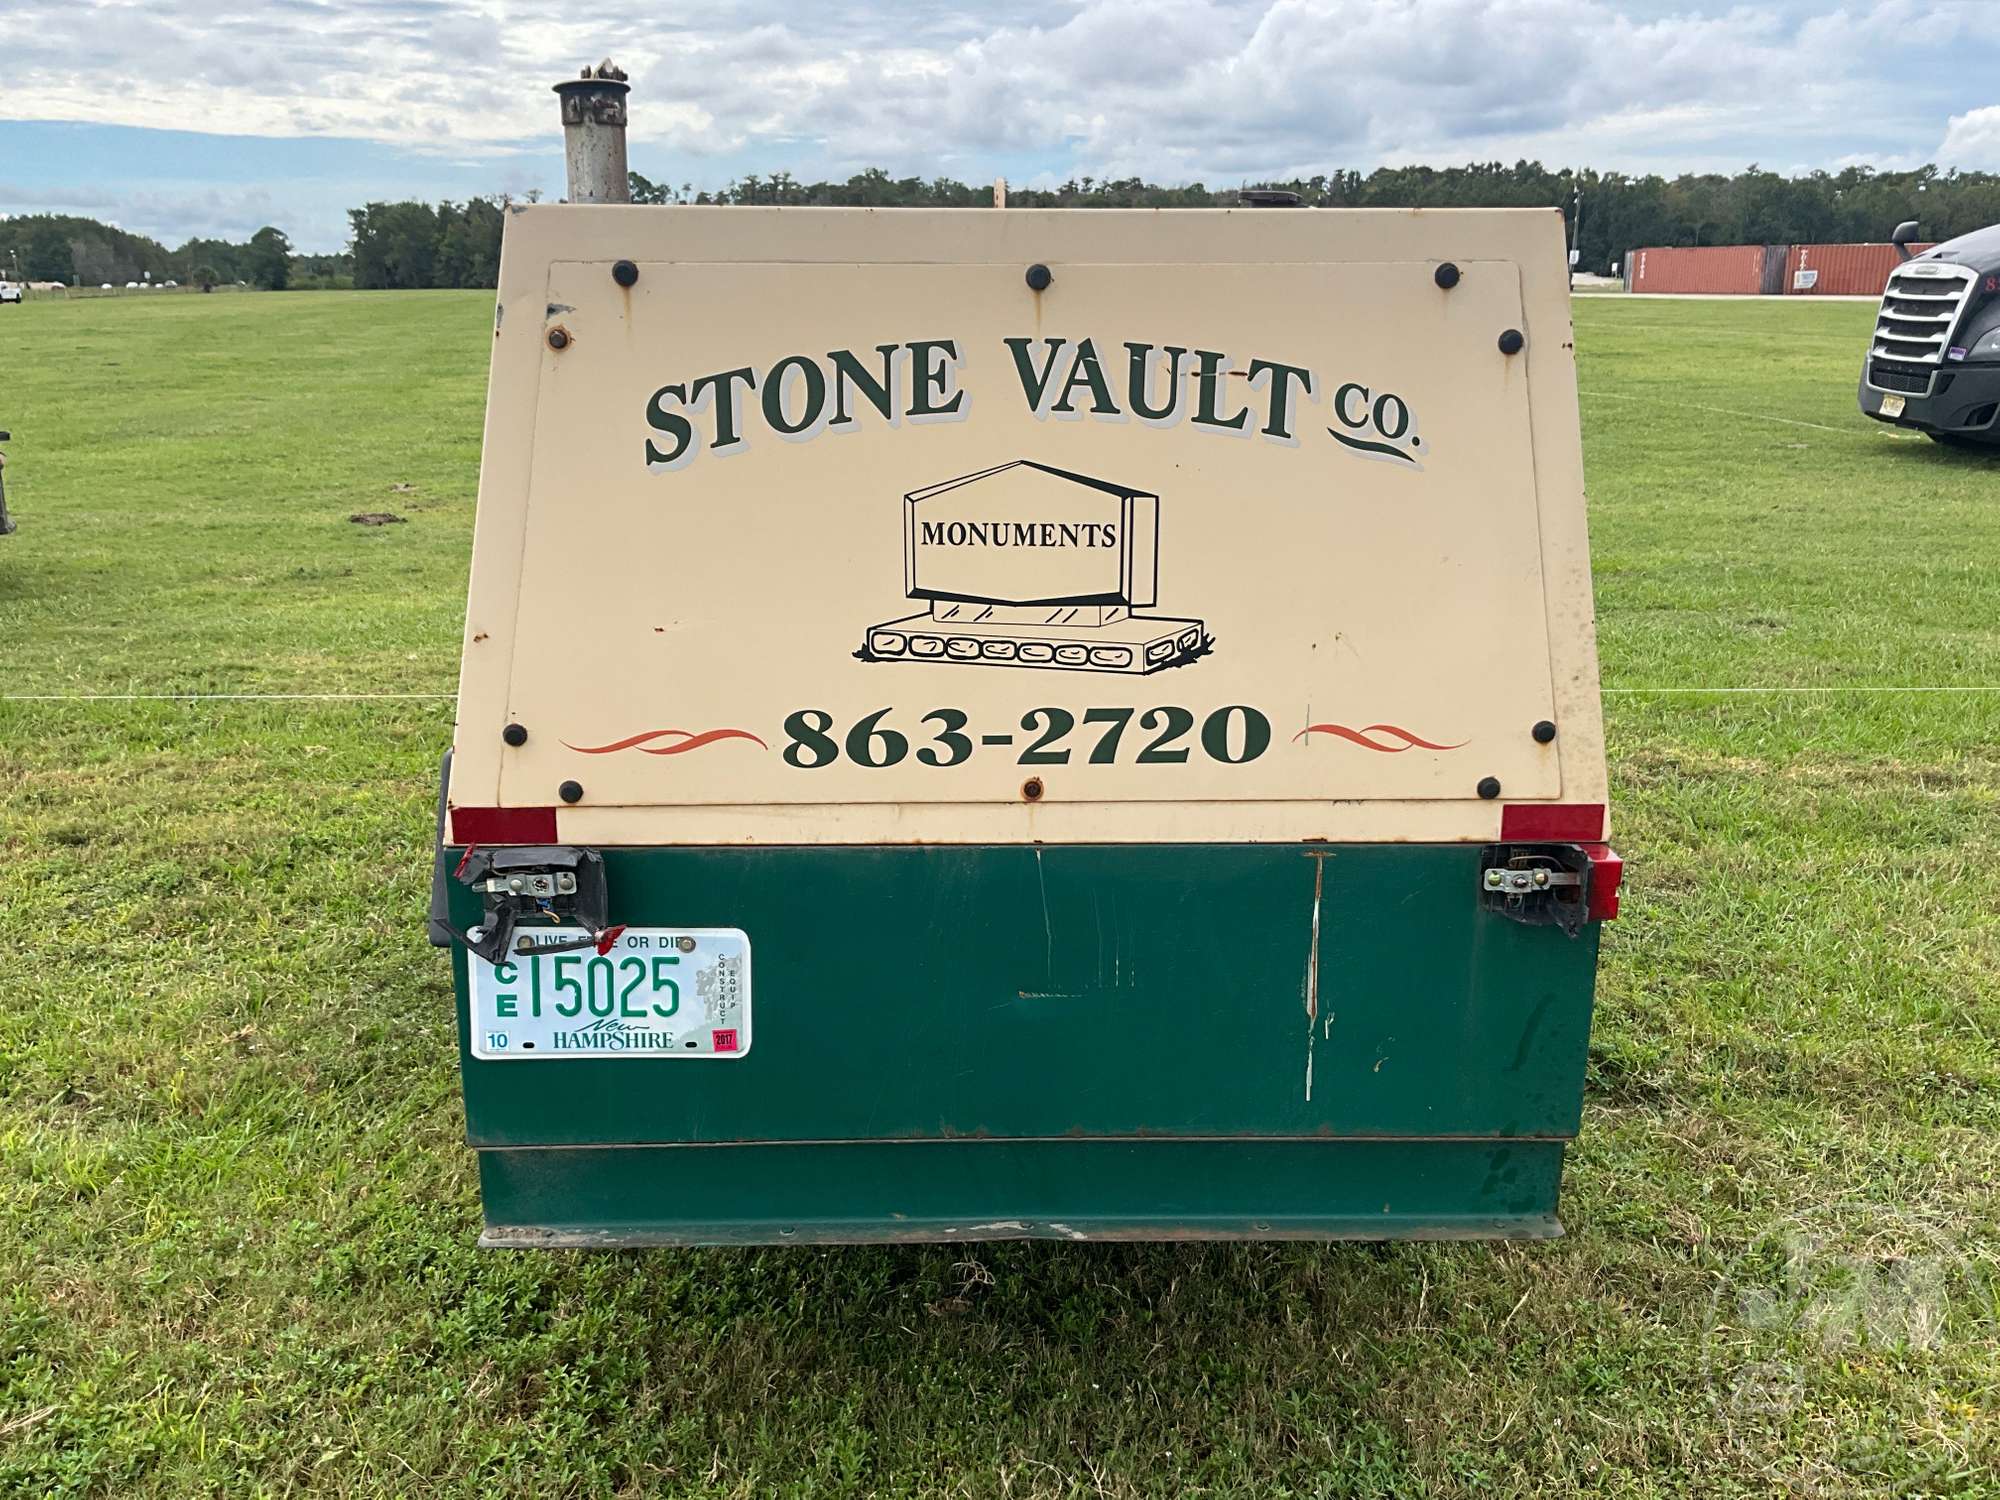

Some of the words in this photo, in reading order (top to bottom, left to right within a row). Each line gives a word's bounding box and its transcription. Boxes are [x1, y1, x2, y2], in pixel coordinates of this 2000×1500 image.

[645, 338, 965, 467] STONE
[1002, 336, 1313, 440] VAULT
[921, 520, 1117, 549] MONUMENTS
[782, 704, 1272, 769] 863-2720
[627, 936, 649, 948] OR
[530, 955, 681, 1018] 15025
[718, 953, 726, 1024] CONSTRUCT
[575, 1019, 650, 1033] New
[487, 1033, 508, 1048] 10
[553, 1031, 675, 1051] HAMPSHIRE
[716, 1034, 733, 1045] 2017
